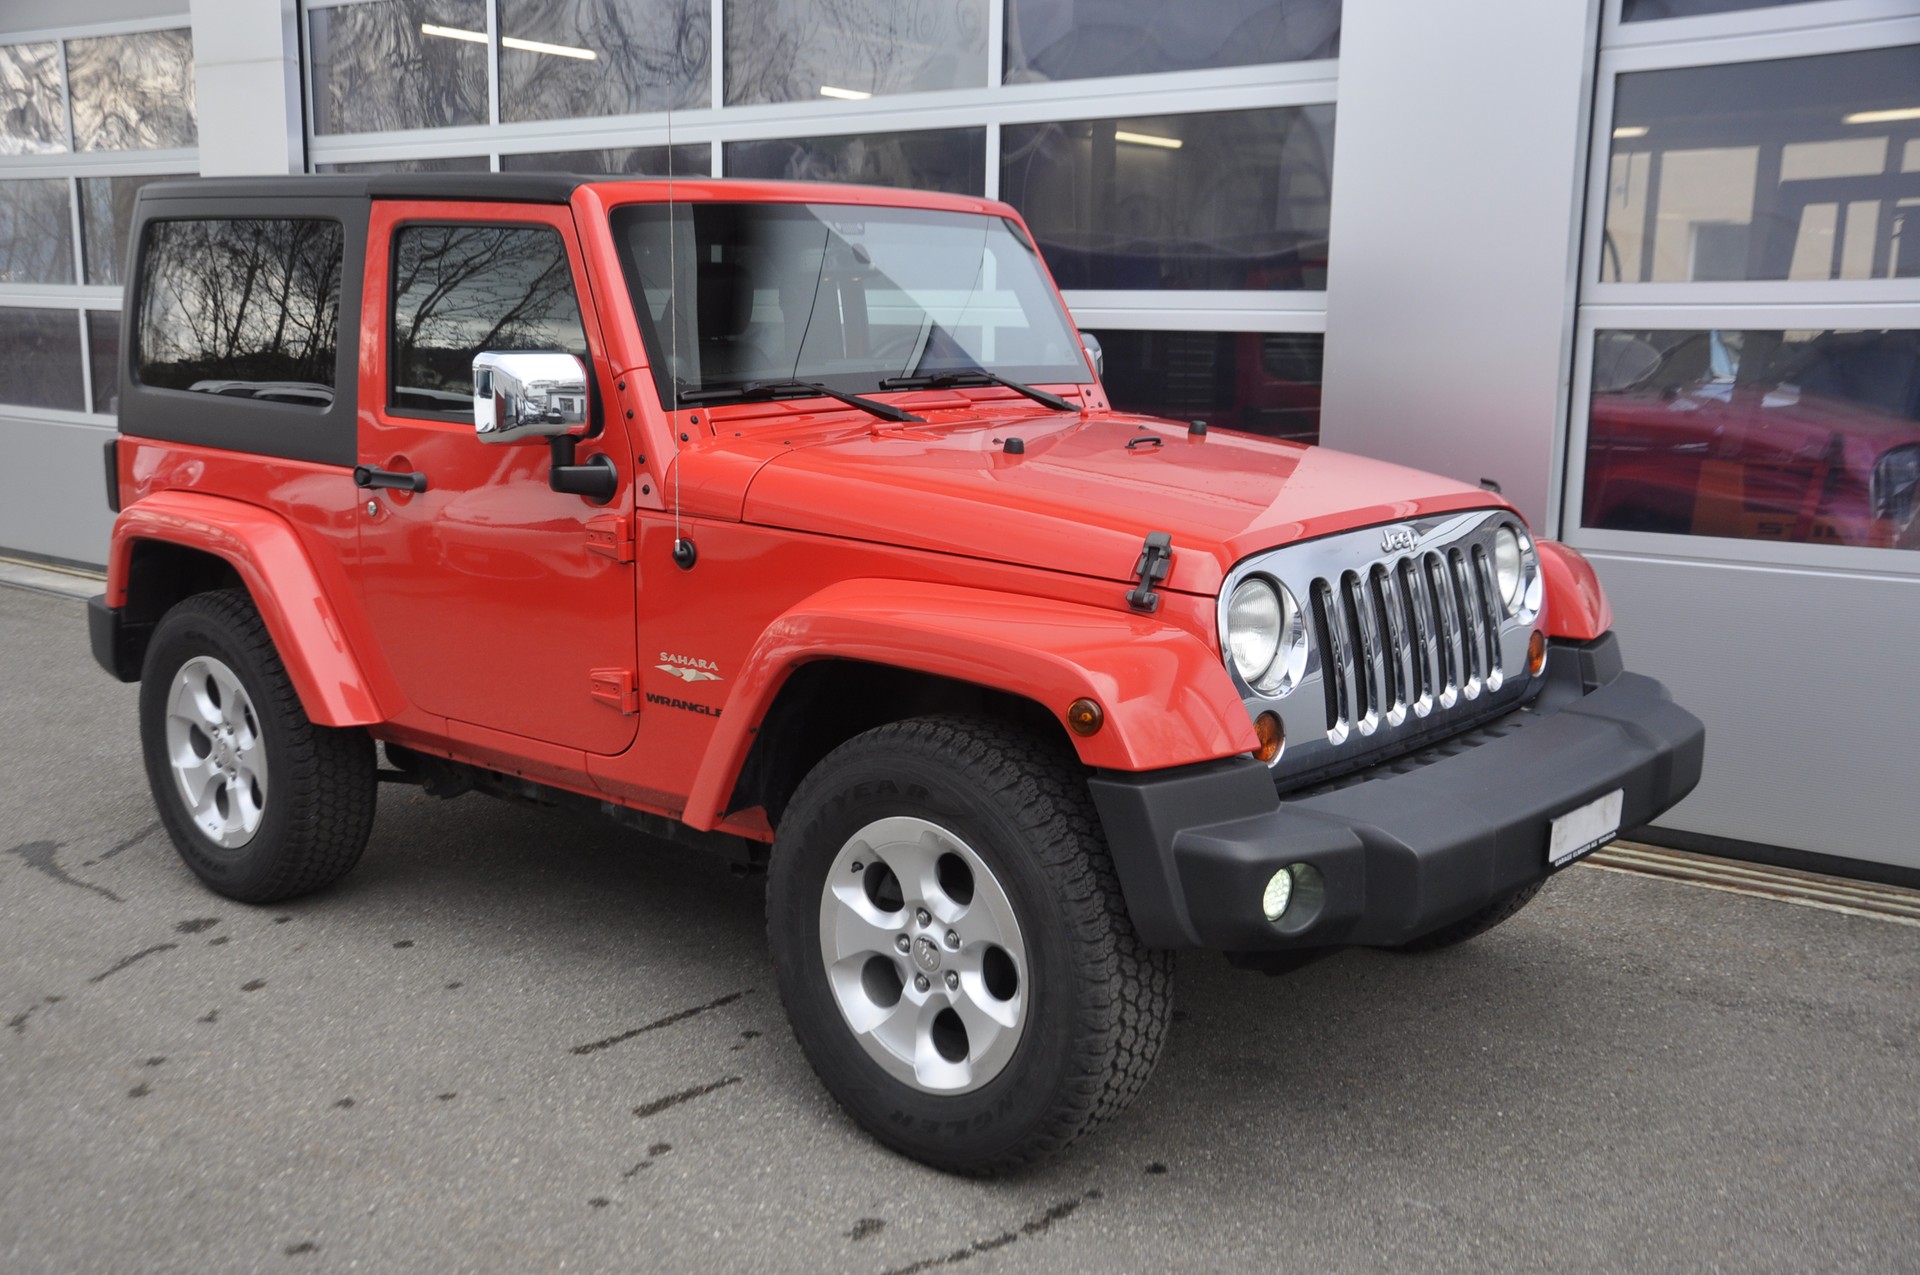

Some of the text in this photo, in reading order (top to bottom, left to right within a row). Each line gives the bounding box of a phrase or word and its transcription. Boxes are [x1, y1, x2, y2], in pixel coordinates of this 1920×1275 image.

[1381, 529, 1418, 553] Jeep
[660, 651, 719, 671] SAHARA
[646, 692, 722, 717] WRANGLE
